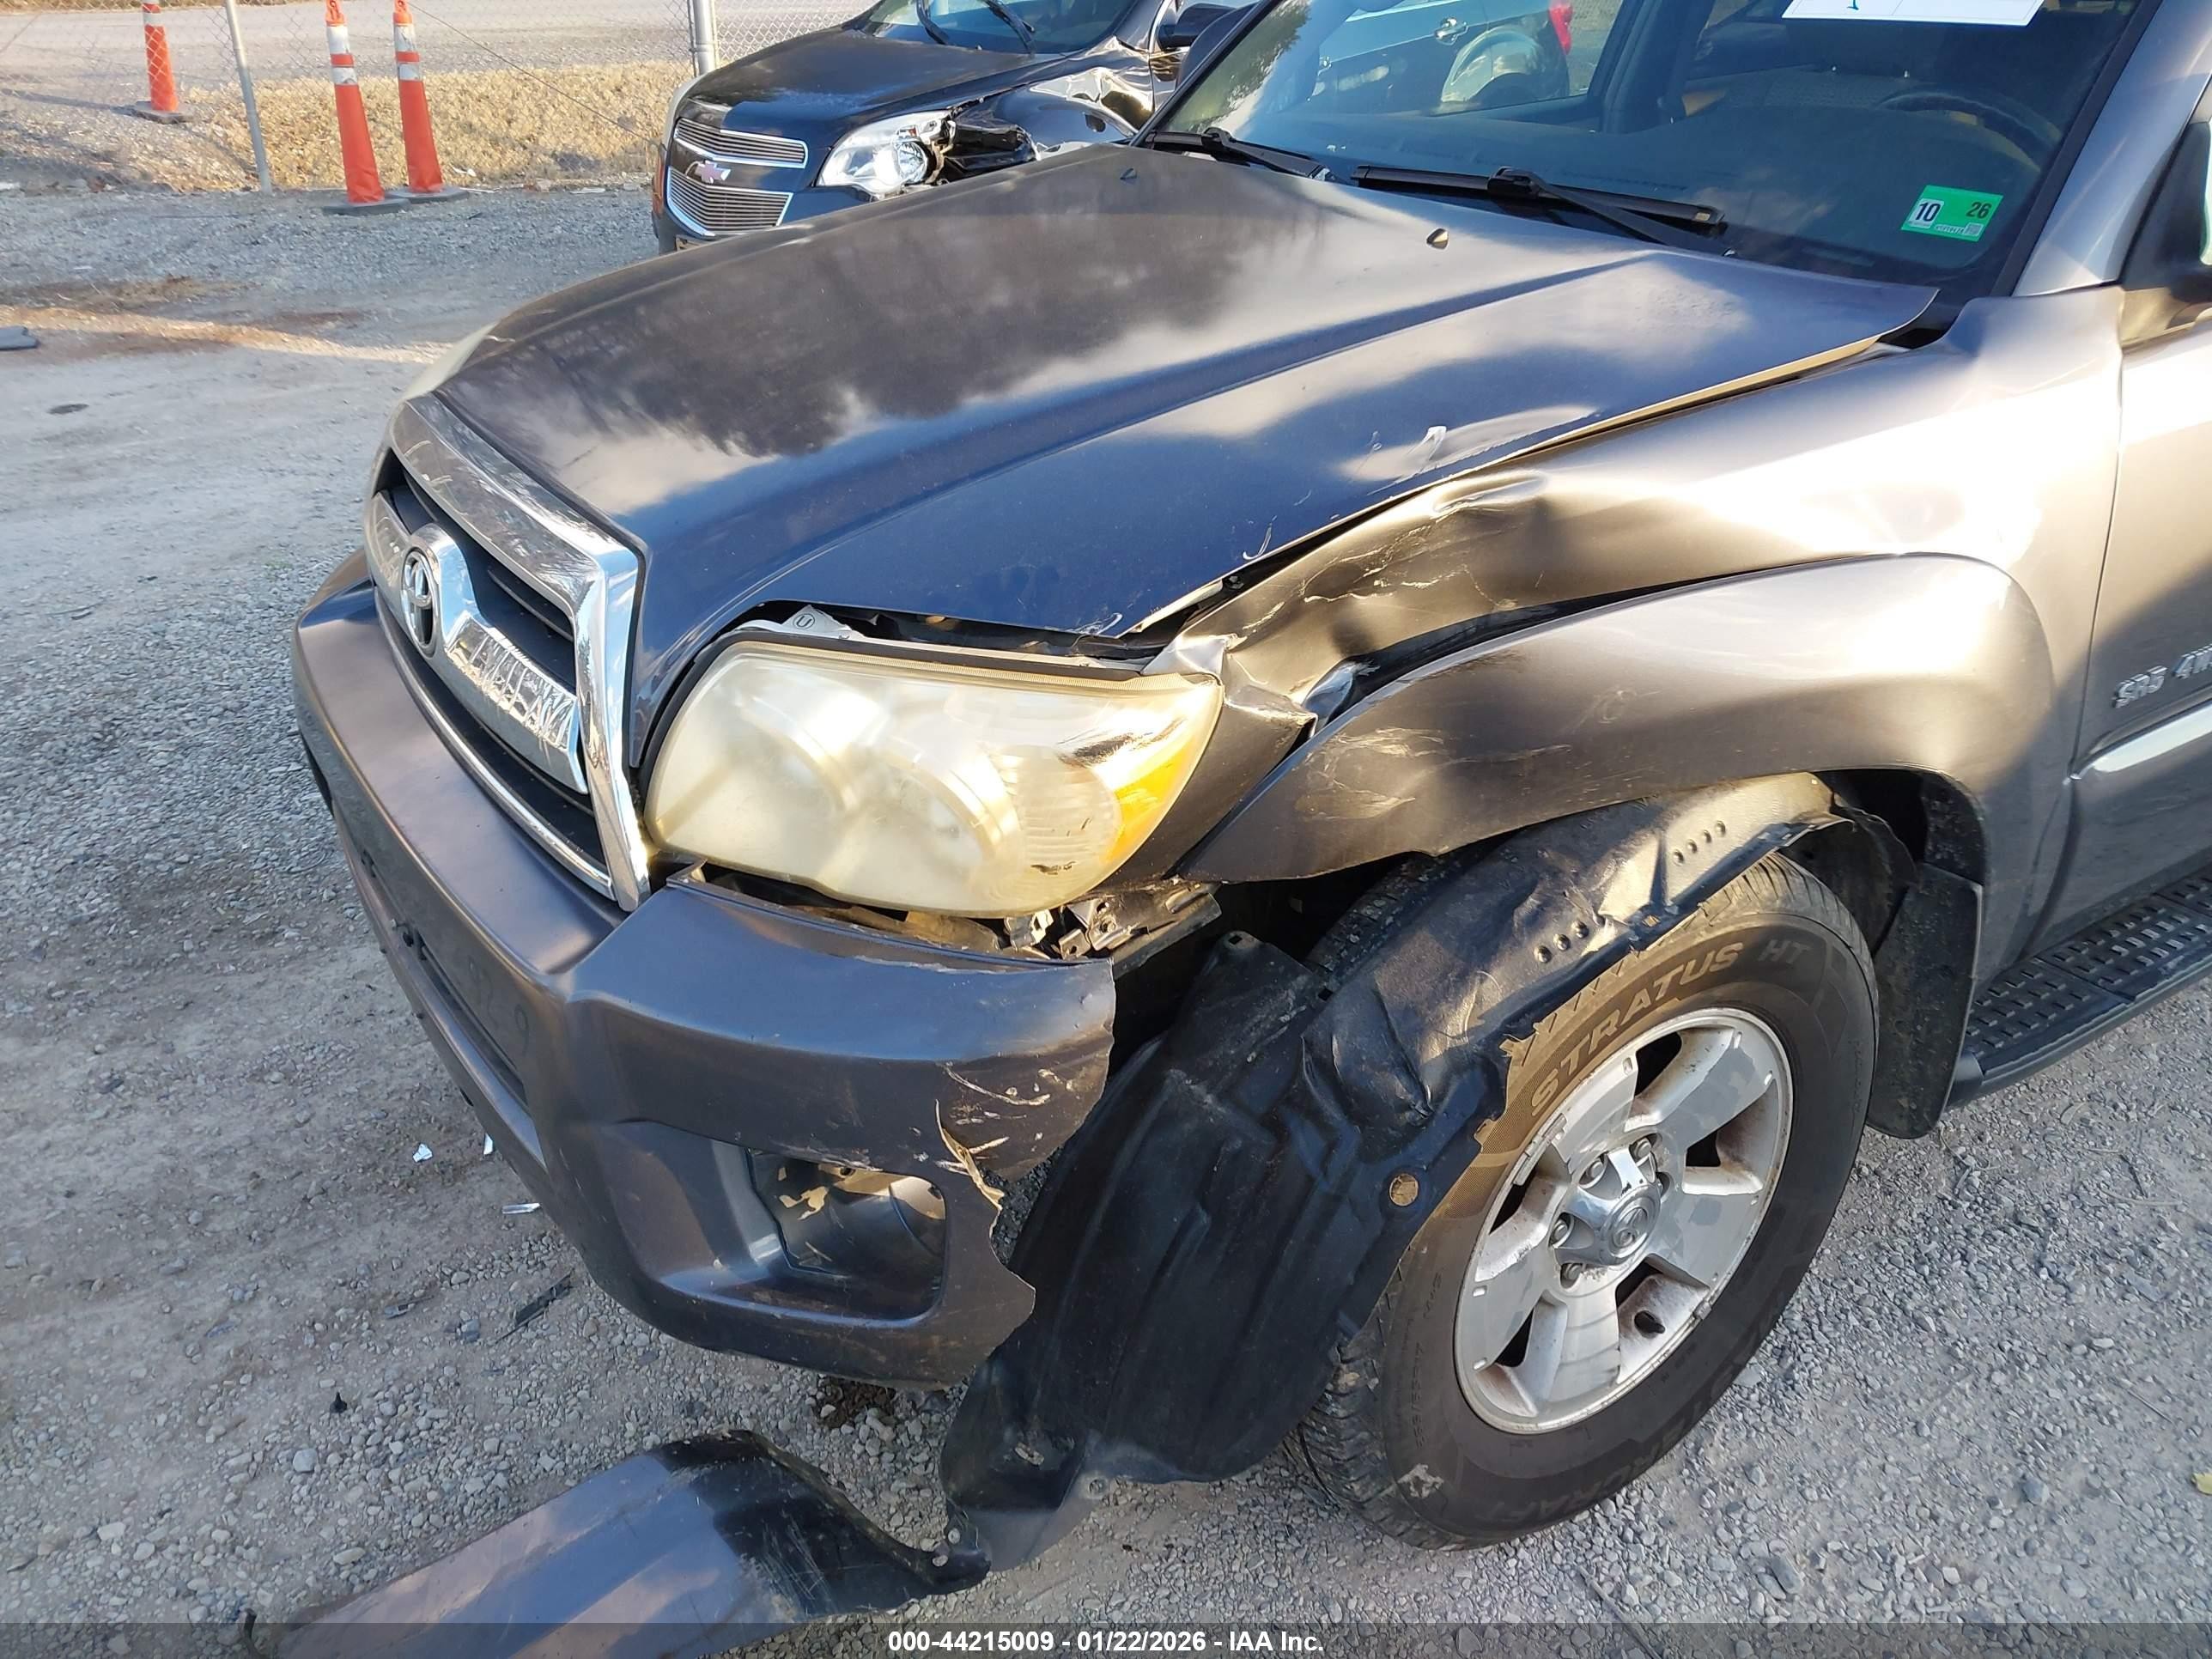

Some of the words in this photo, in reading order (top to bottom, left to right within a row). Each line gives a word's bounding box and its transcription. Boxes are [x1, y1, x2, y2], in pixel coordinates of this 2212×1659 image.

[1915, 202, 1941, 222] 10
[1965, 201, 1992, 219] 26
[1531, 942, 1744, 1115] STRATUS
[1758, 939, 1812, 964] HT
